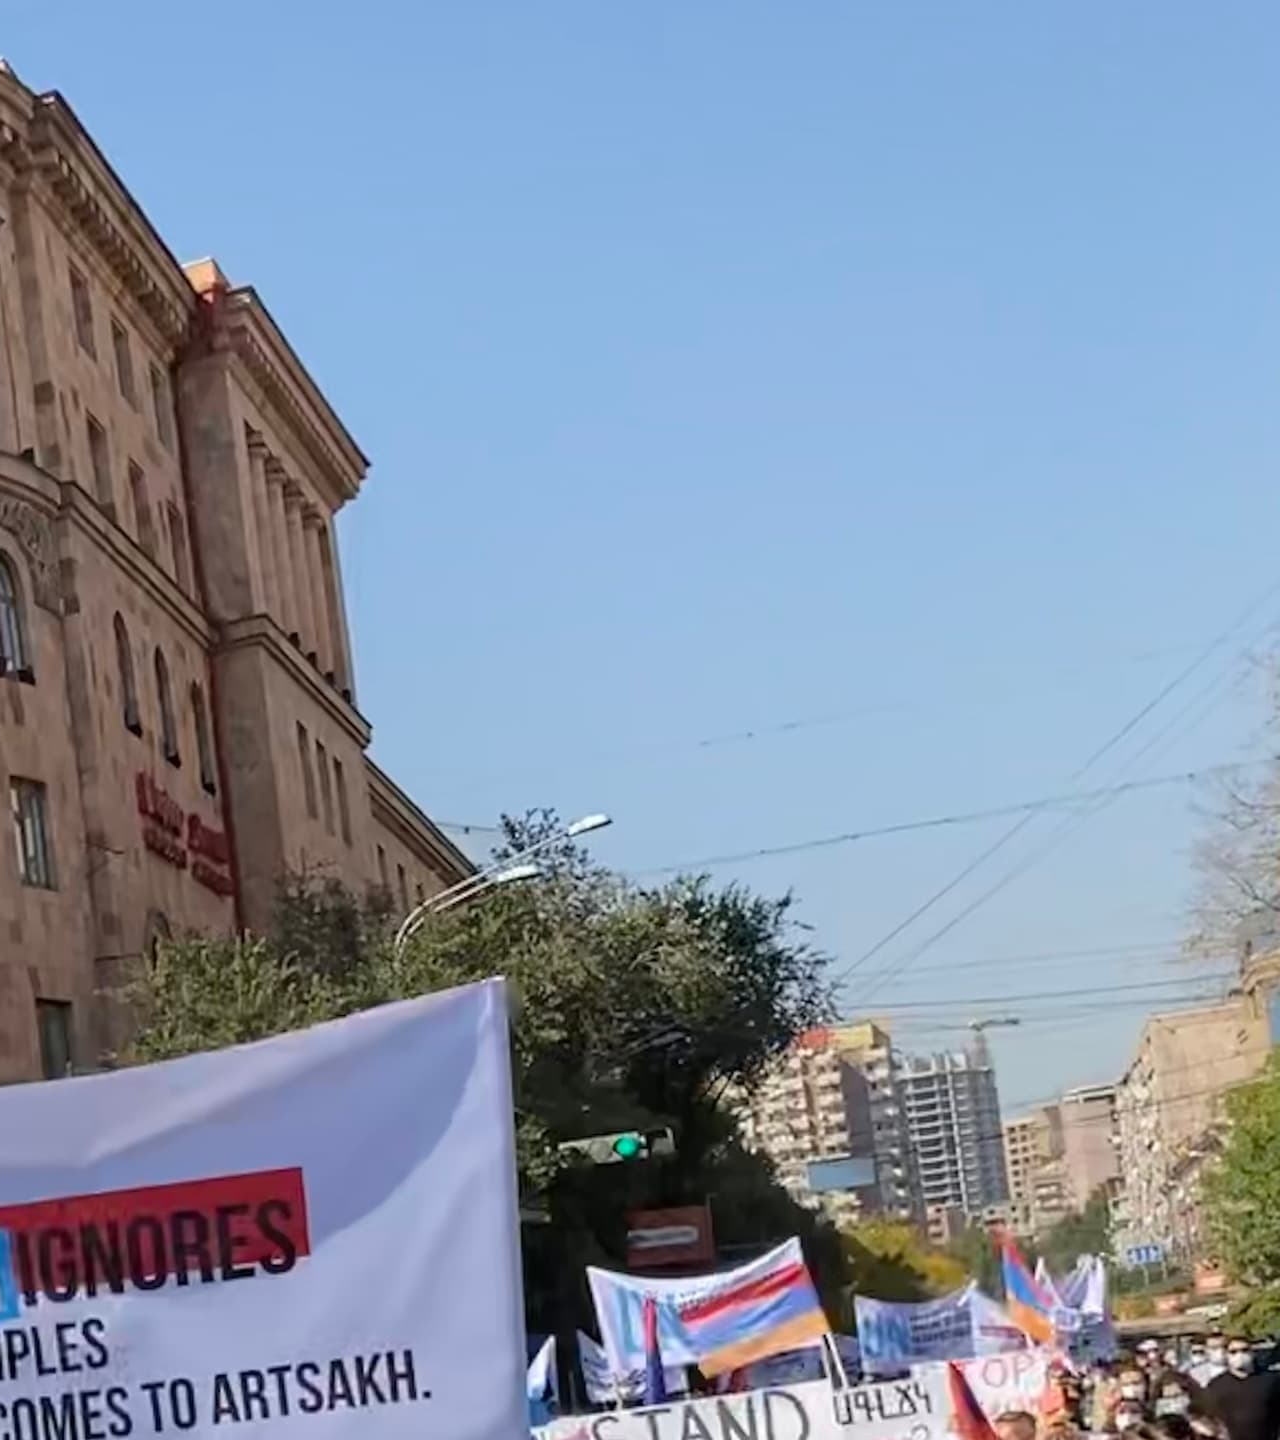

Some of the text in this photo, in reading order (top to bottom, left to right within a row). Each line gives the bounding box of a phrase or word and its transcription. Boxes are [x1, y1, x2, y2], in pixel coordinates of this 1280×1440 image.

[15, 1199, 298, 1308] IGNORES
[141, 1378, 197, 1432] TO
[212, 1349, 432, 1425] ARTSAKH.
